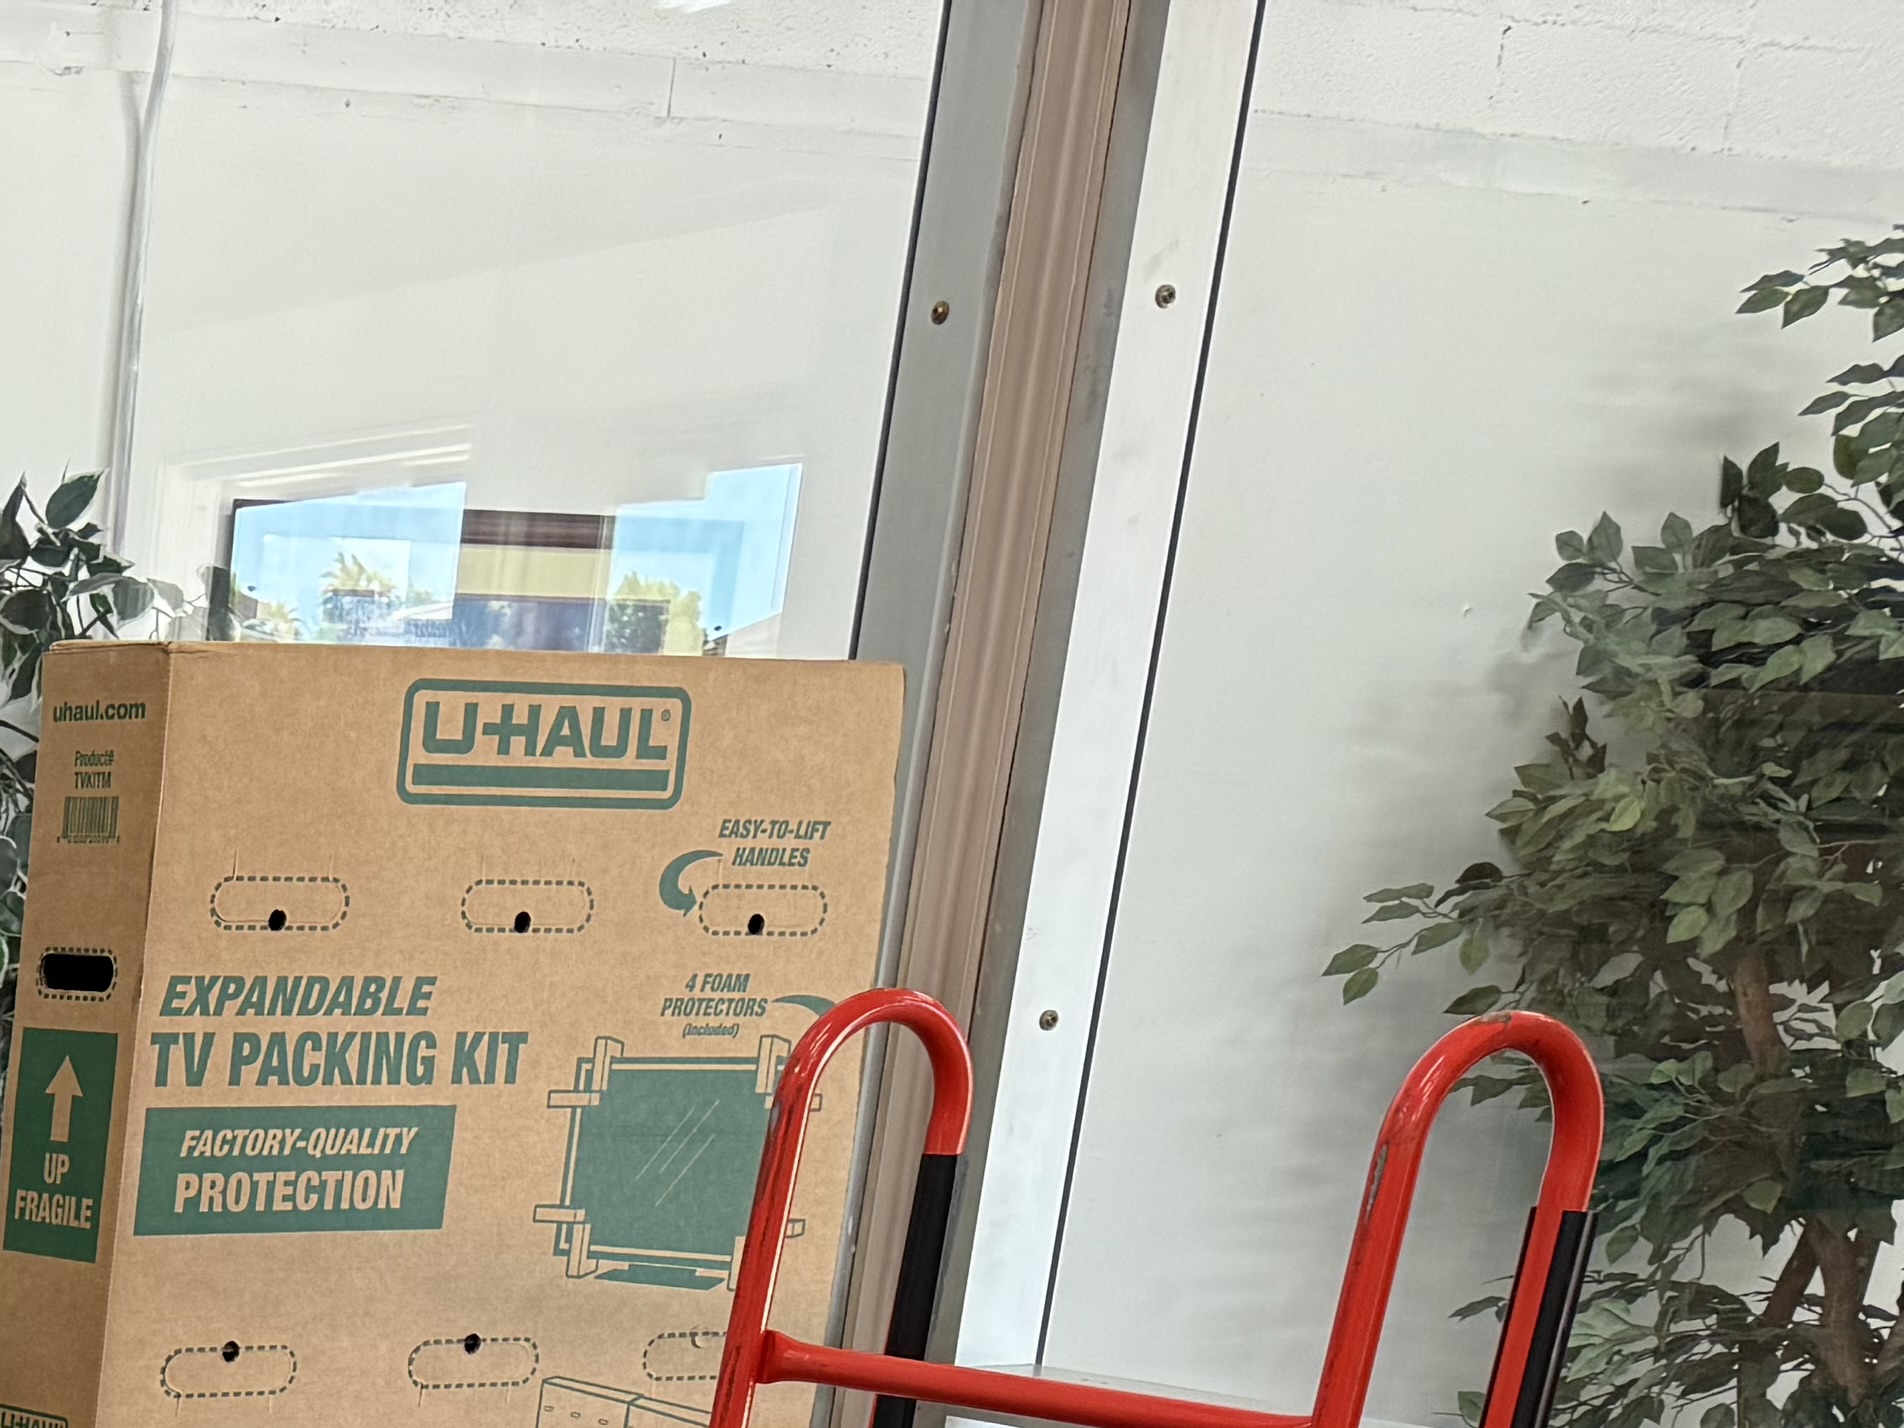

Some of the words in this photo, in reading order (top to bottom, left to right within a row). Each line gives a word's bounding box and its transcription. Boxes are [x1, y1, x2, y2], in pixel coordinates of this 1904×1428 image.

[52, 697, 146, 724] uhaul.com
[718, 819, 831, 840] EASY-TO-LIFT
[732, 848, 810, 867] HANDLES
[159, 975, 437, 1017] EXPANDABLE
[685, 973, 698, 992] 4
[700, 973, 750, 993] FOAM
[660, 998, 767, 1017] PROTECTORS
[151, 1032, 213, 1088] TV
[228, 1031, 437, 1087] PACKING
[451, 1032, 528, 1086] KIT
[180, 1127, 418, 1158] FACTORY-QUALITY
[43, 1154, 70, 1184] UP
[173, 1168, 405, 1215] PROTECTION
[15, 1191, 92, 1230] FRAGILE
